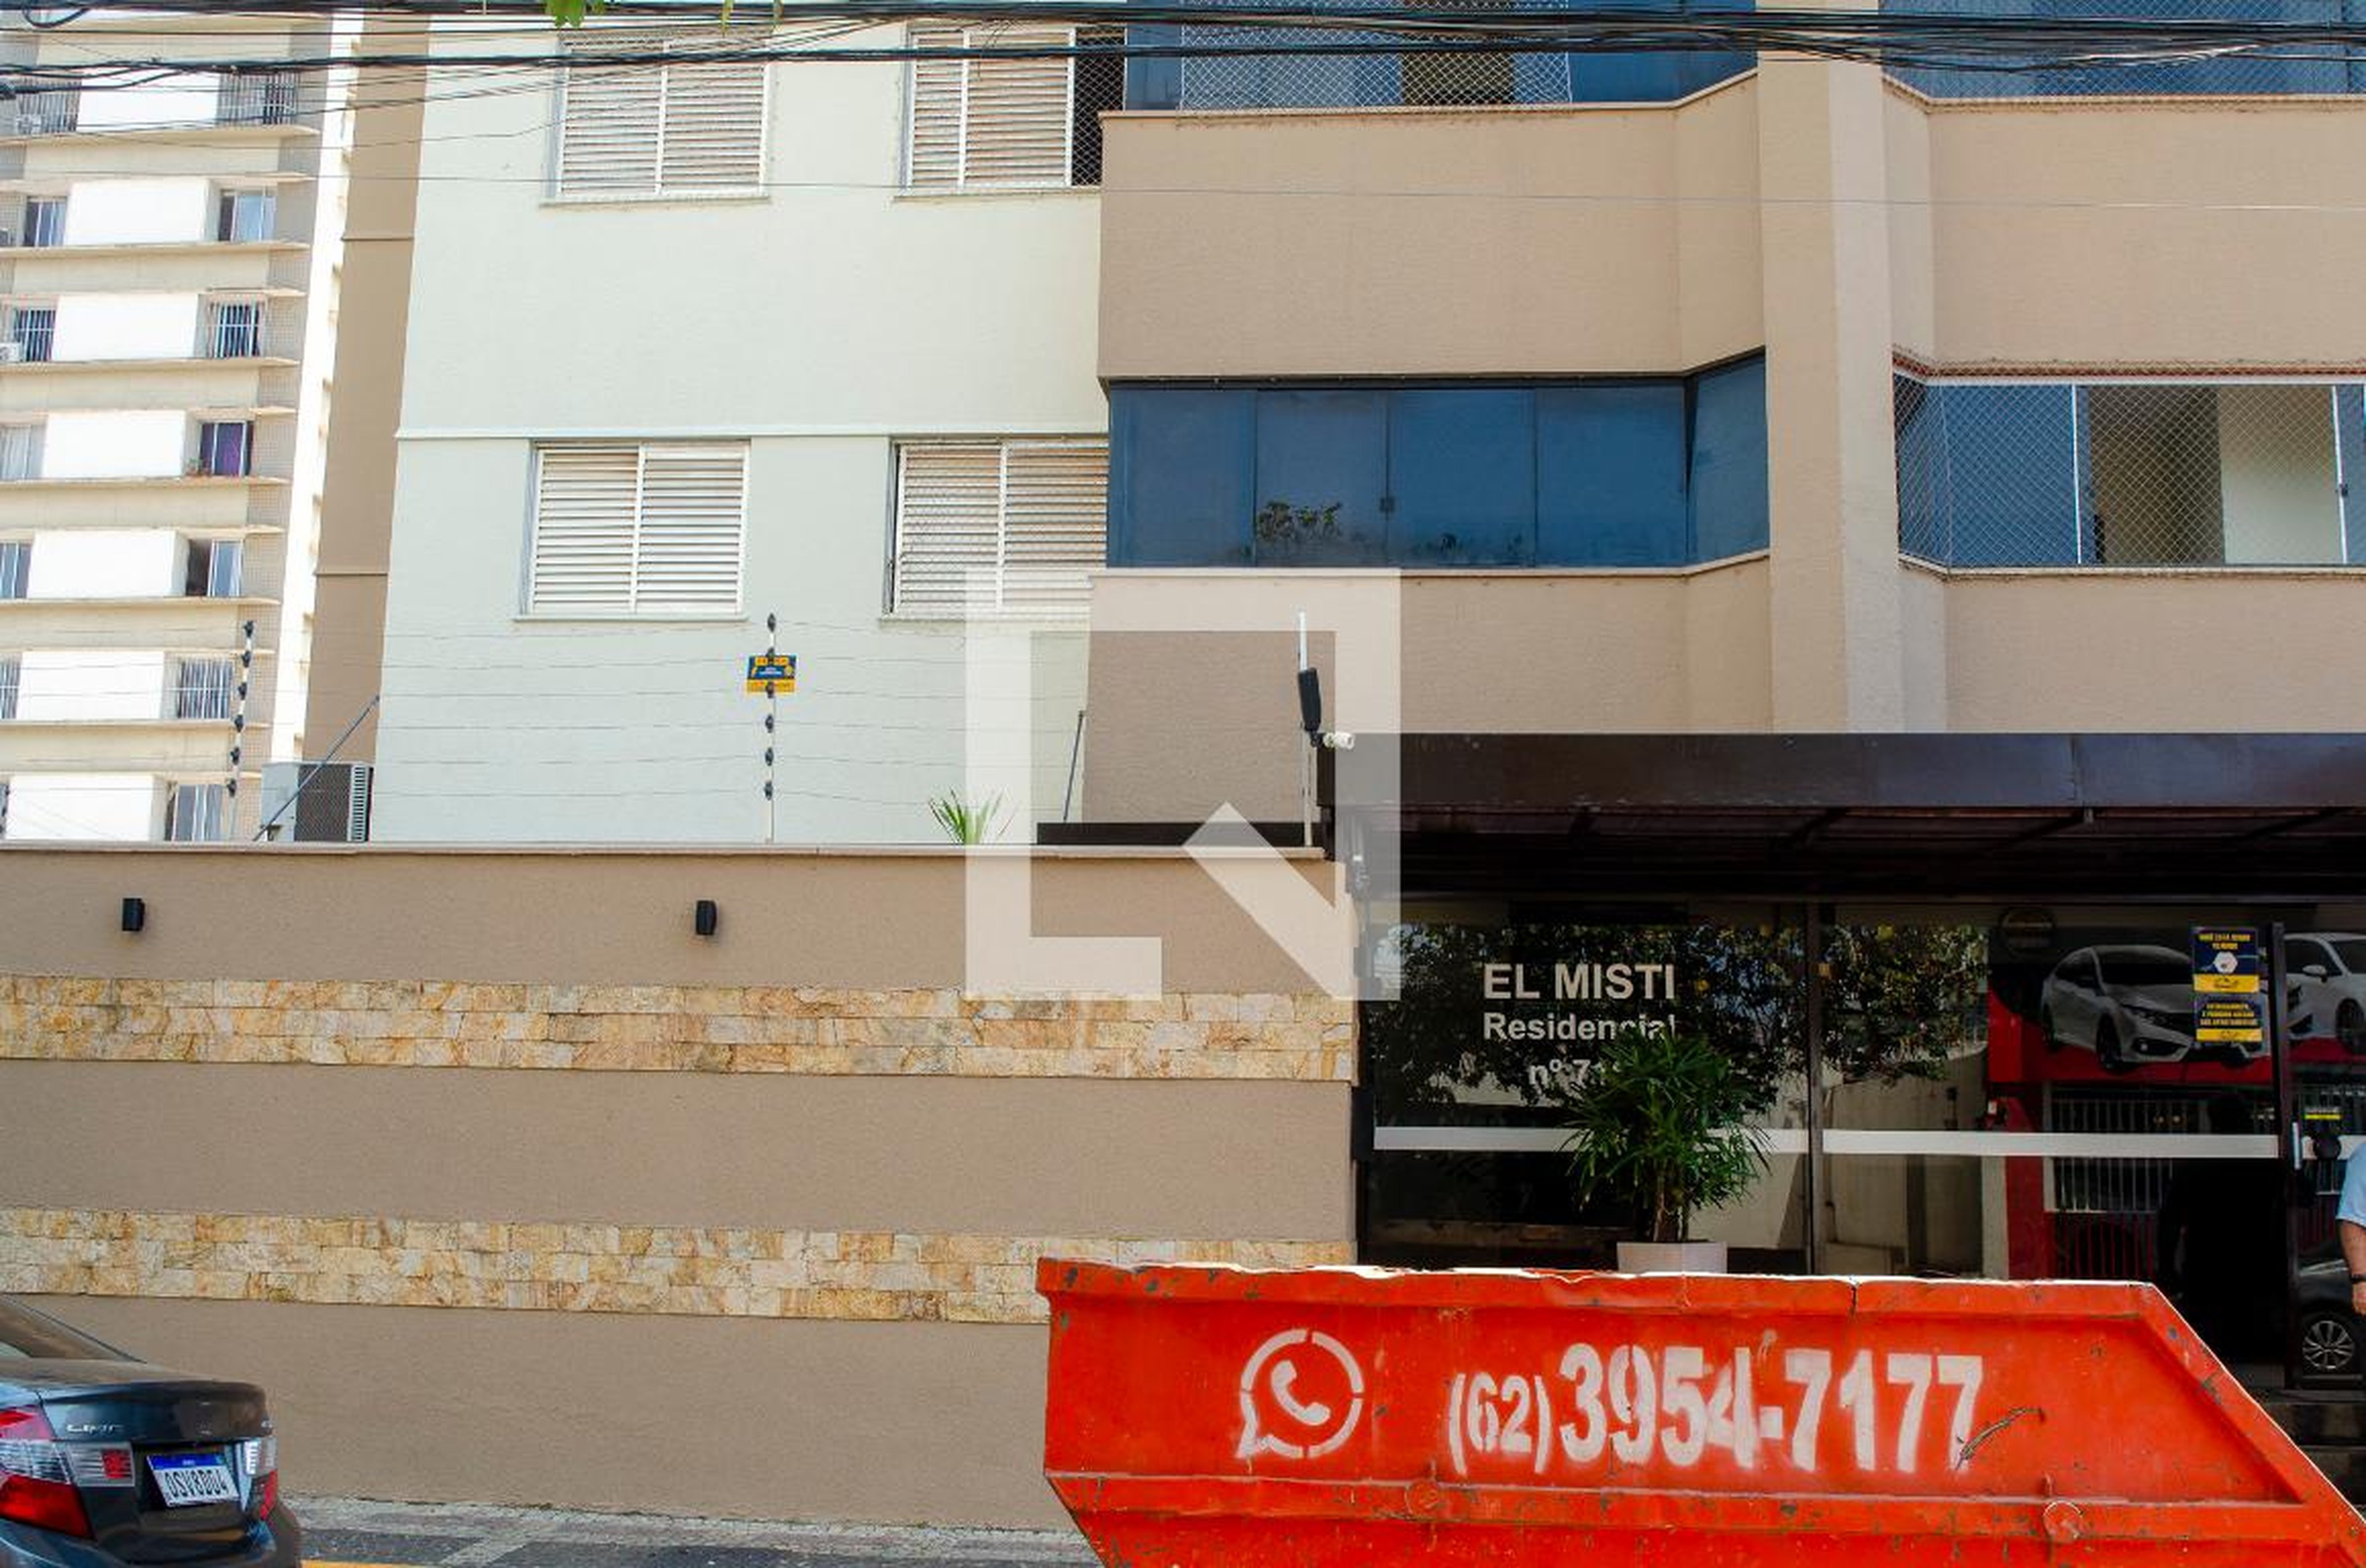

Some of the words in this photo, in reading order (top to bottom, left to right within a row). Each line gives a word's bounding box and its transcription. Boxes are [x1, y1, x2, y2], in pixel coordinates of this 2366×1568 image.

[1484, 963, 1540, 999] EL
[1555, 963, 1674, 999] MISTI
[1559, 1343, 1983, 1474] 3954-7177
